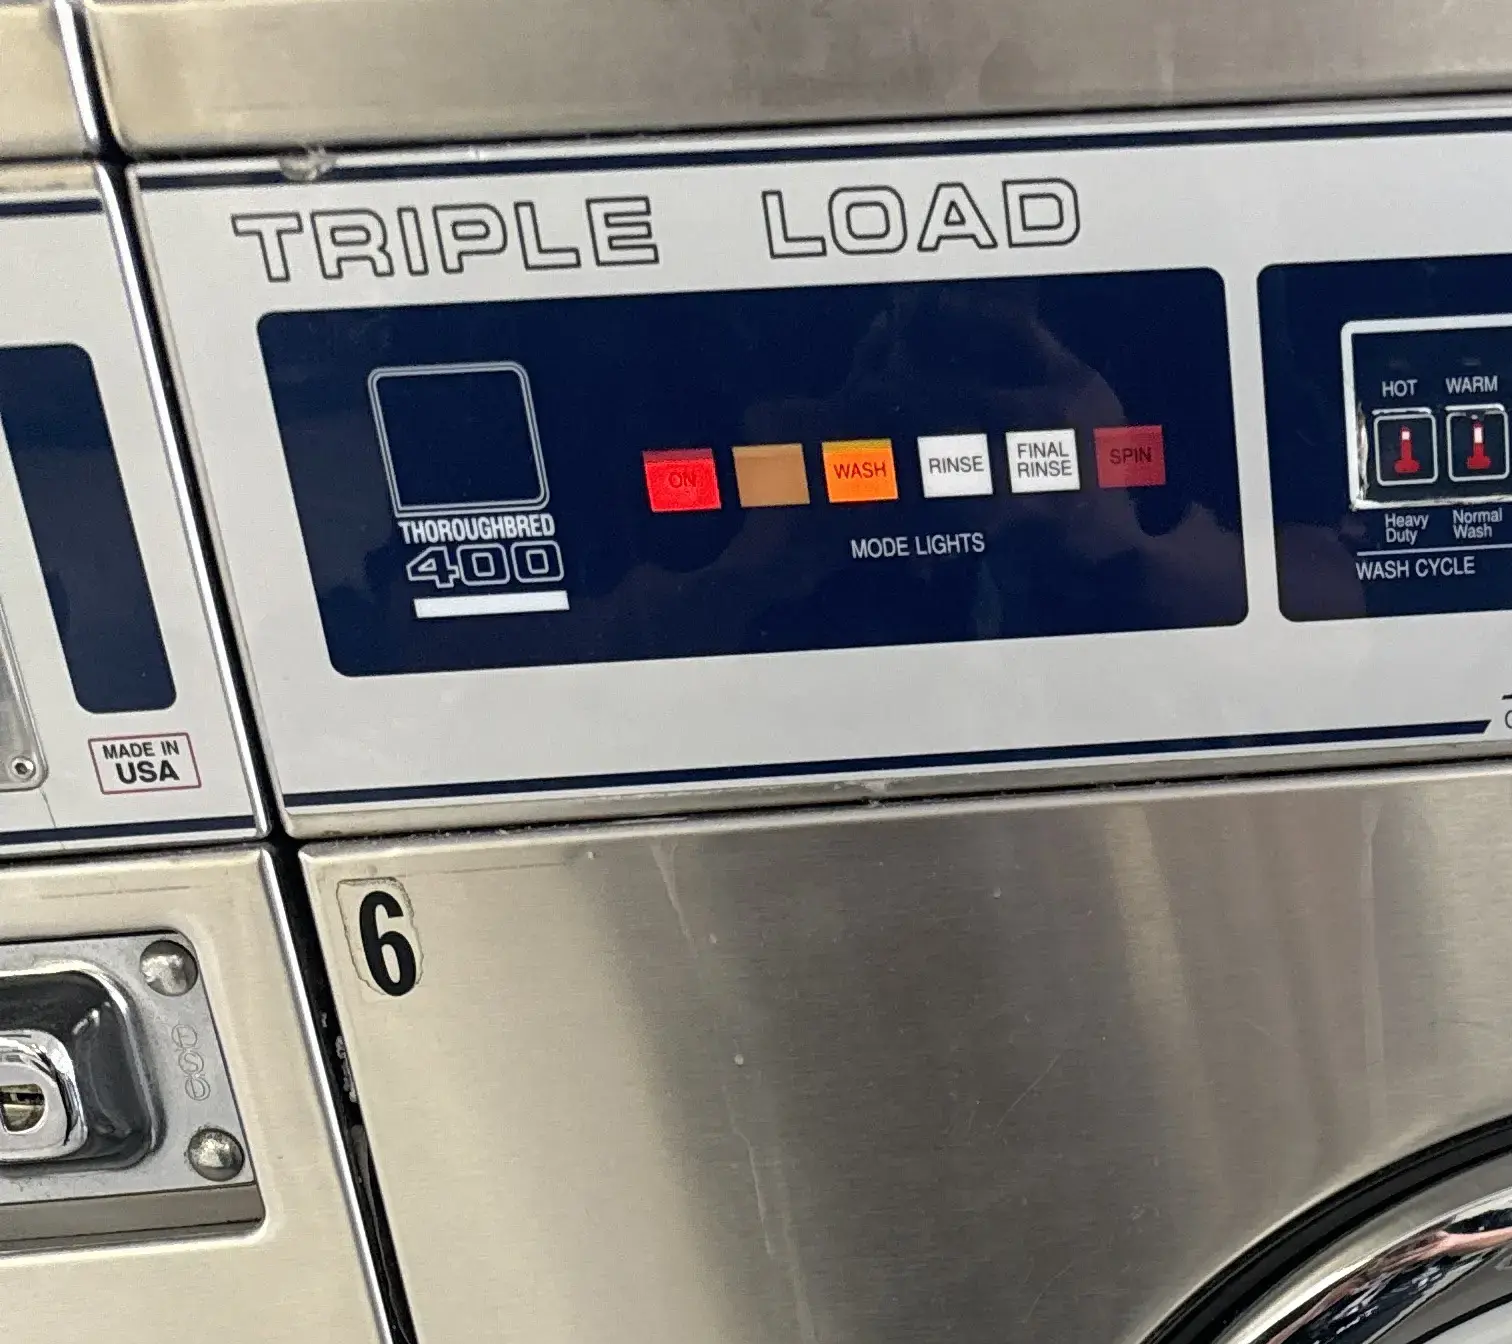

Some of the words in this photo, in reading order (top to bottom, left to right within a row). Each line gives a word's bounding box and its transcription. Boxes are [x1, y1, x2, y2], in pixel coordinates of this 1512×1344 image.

[231, 197, 659, 282] TRIPLE
[762, 178, 1080, 258] LOAD
[1382, 379, 1417, 397] HOT
[1446, 375, 1498, 394] WARM
[1017, 442, 1069, 459] FINAL
[1110, 446, 1152, 465] SPIN
[834, 461, 887, 479] WASH
[928, 456, 984, 474] RINSE
[1017, 460, 1072, 478] RINSE
[668, 470, 697, 489] ON
[1385, 513, 1429, 531] Heavy
[1452, 507, 1503, 525] Normal
[398, 513, 555, 544] THOROUGHBRED
[1385, 527, 1418, 546] Duty
[1453, 523, 1493, 540] Wash
[851, 535, 909, 559] MODE
[916, 532, 985, 555] LIGHTS
[406, 540, 564, 588] 400
[1356, 559, 1409, 581] WASH
[1415, 556, 1475, 578] CYCLE
[103, 741, 155, 760] MADE
[161, 740, 180, 756] IN
[116, 760, 180, 785] USA
[359, 890, 416, 996] 6
